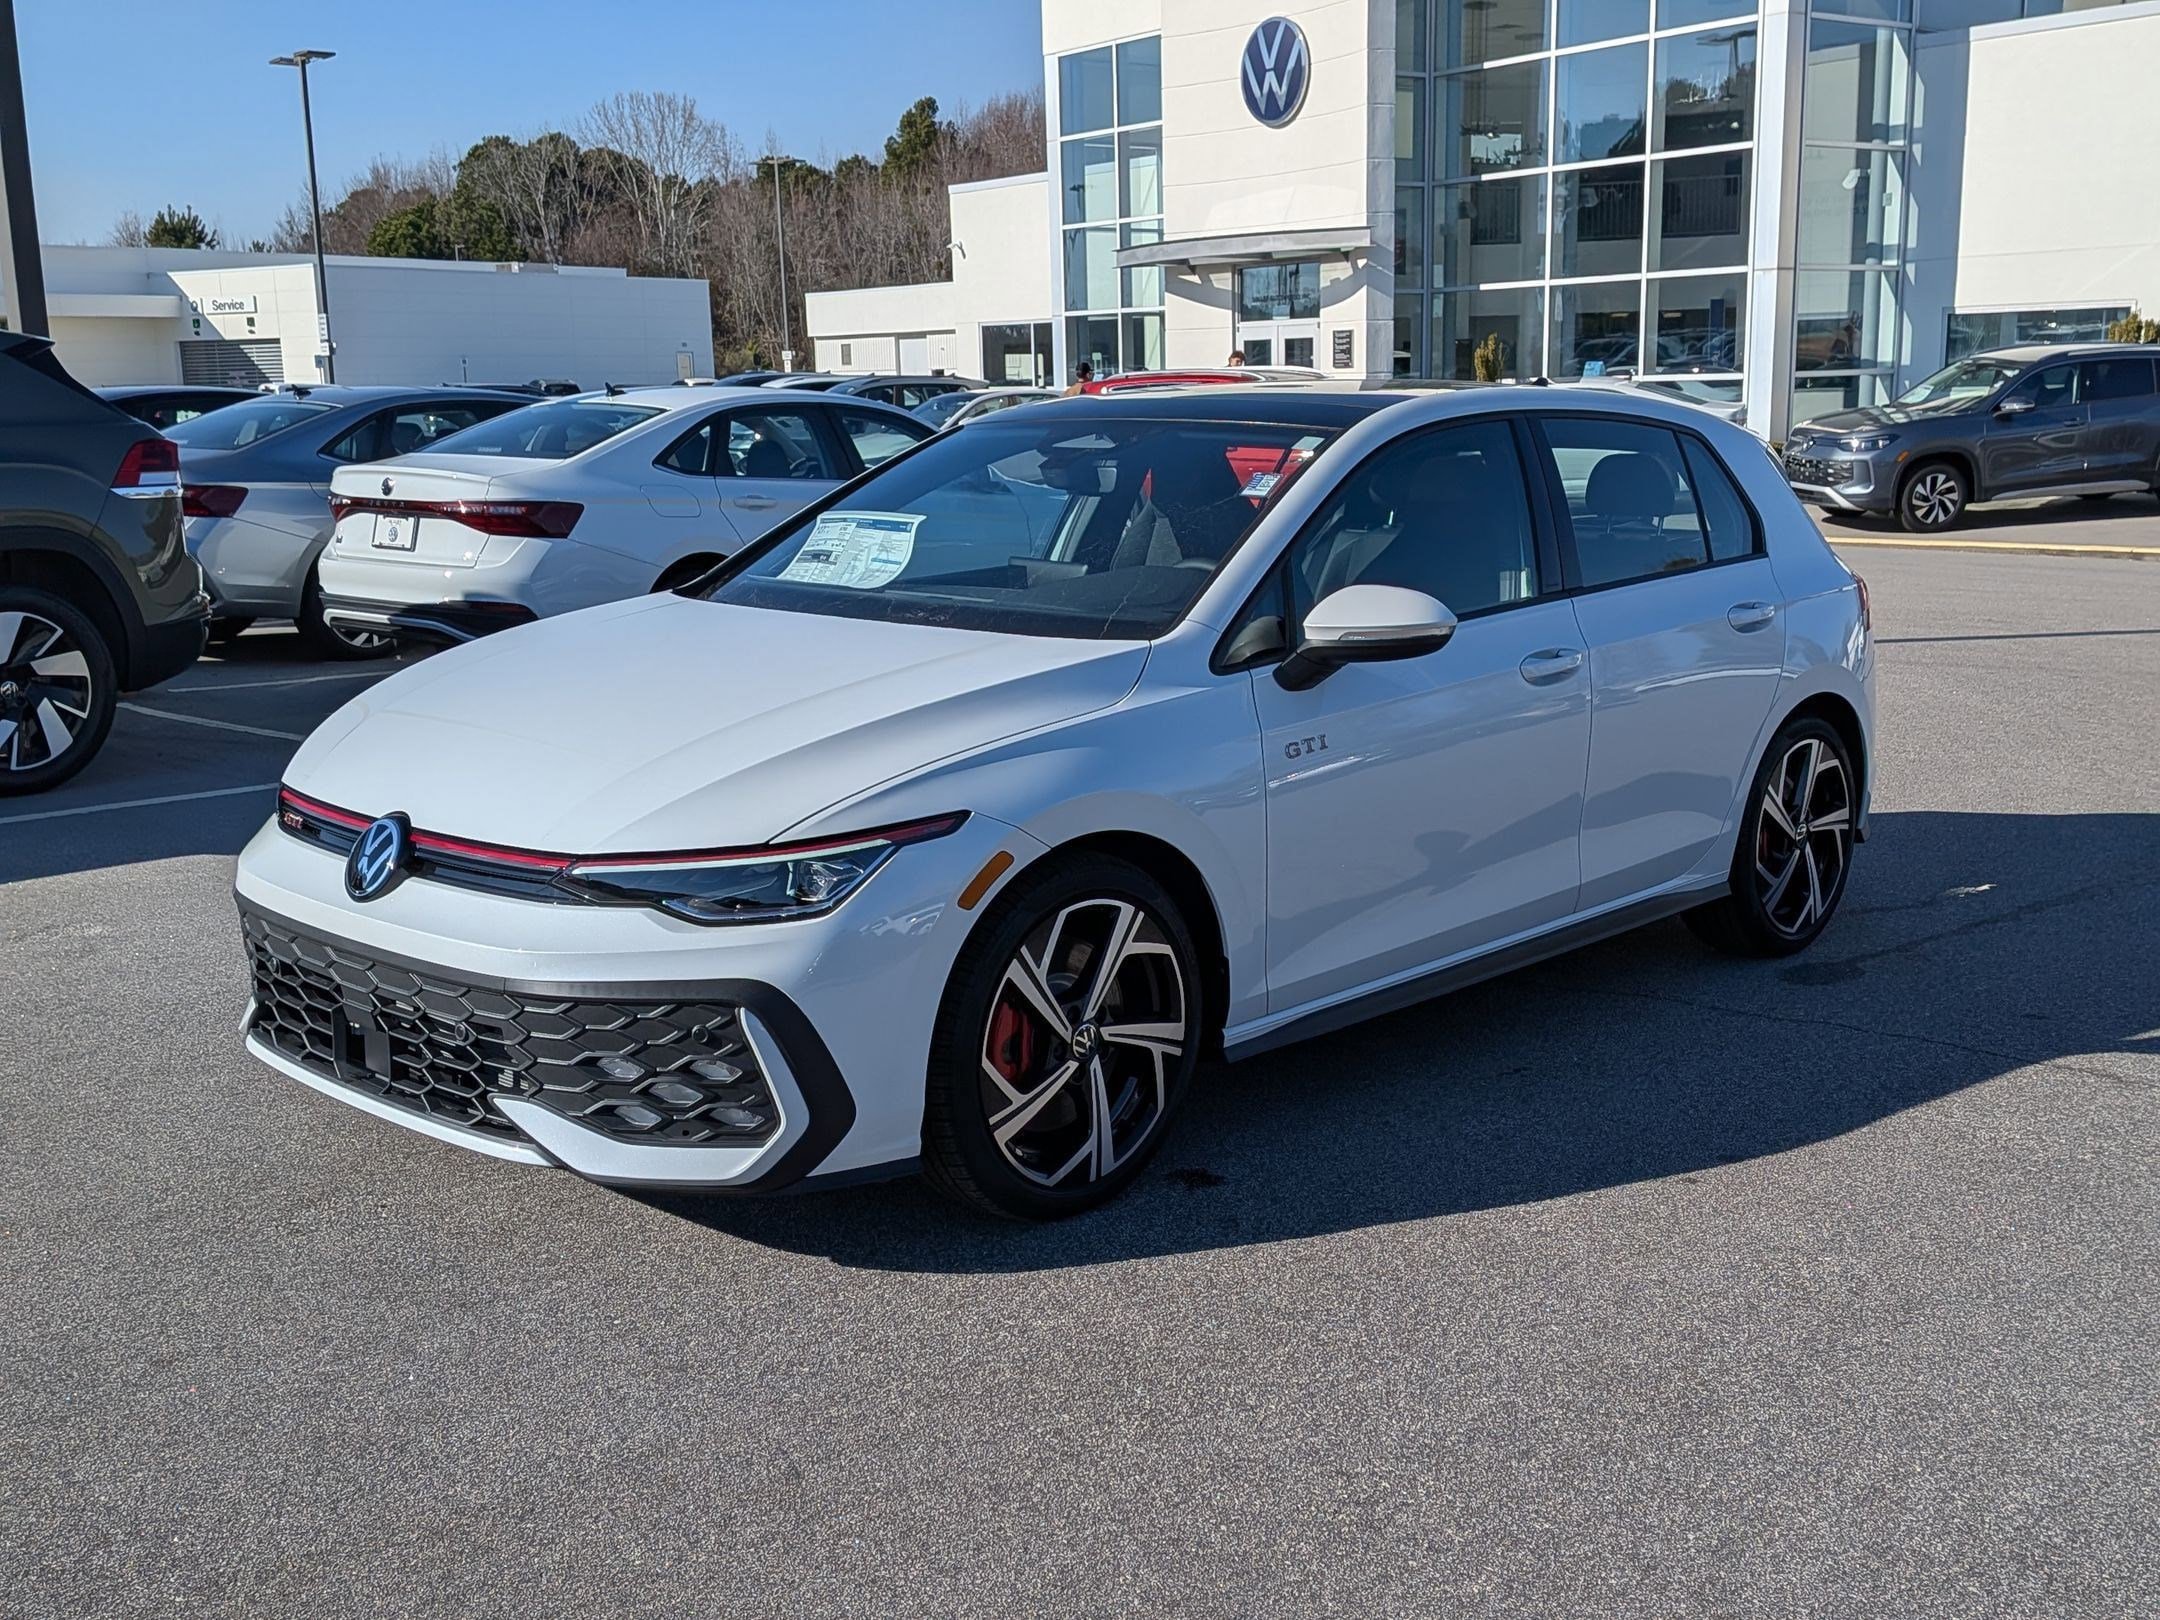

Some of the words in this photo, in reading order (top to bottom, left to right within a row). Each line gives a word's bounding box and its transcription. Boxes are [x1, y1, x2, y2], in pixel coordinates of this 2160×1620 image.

[1243, 18, 1307, 122] VW
[211, 299, 245, 311] Service
[1284, 733, 1329, 760] GTI
[283, 813, 303, 829] GTI
